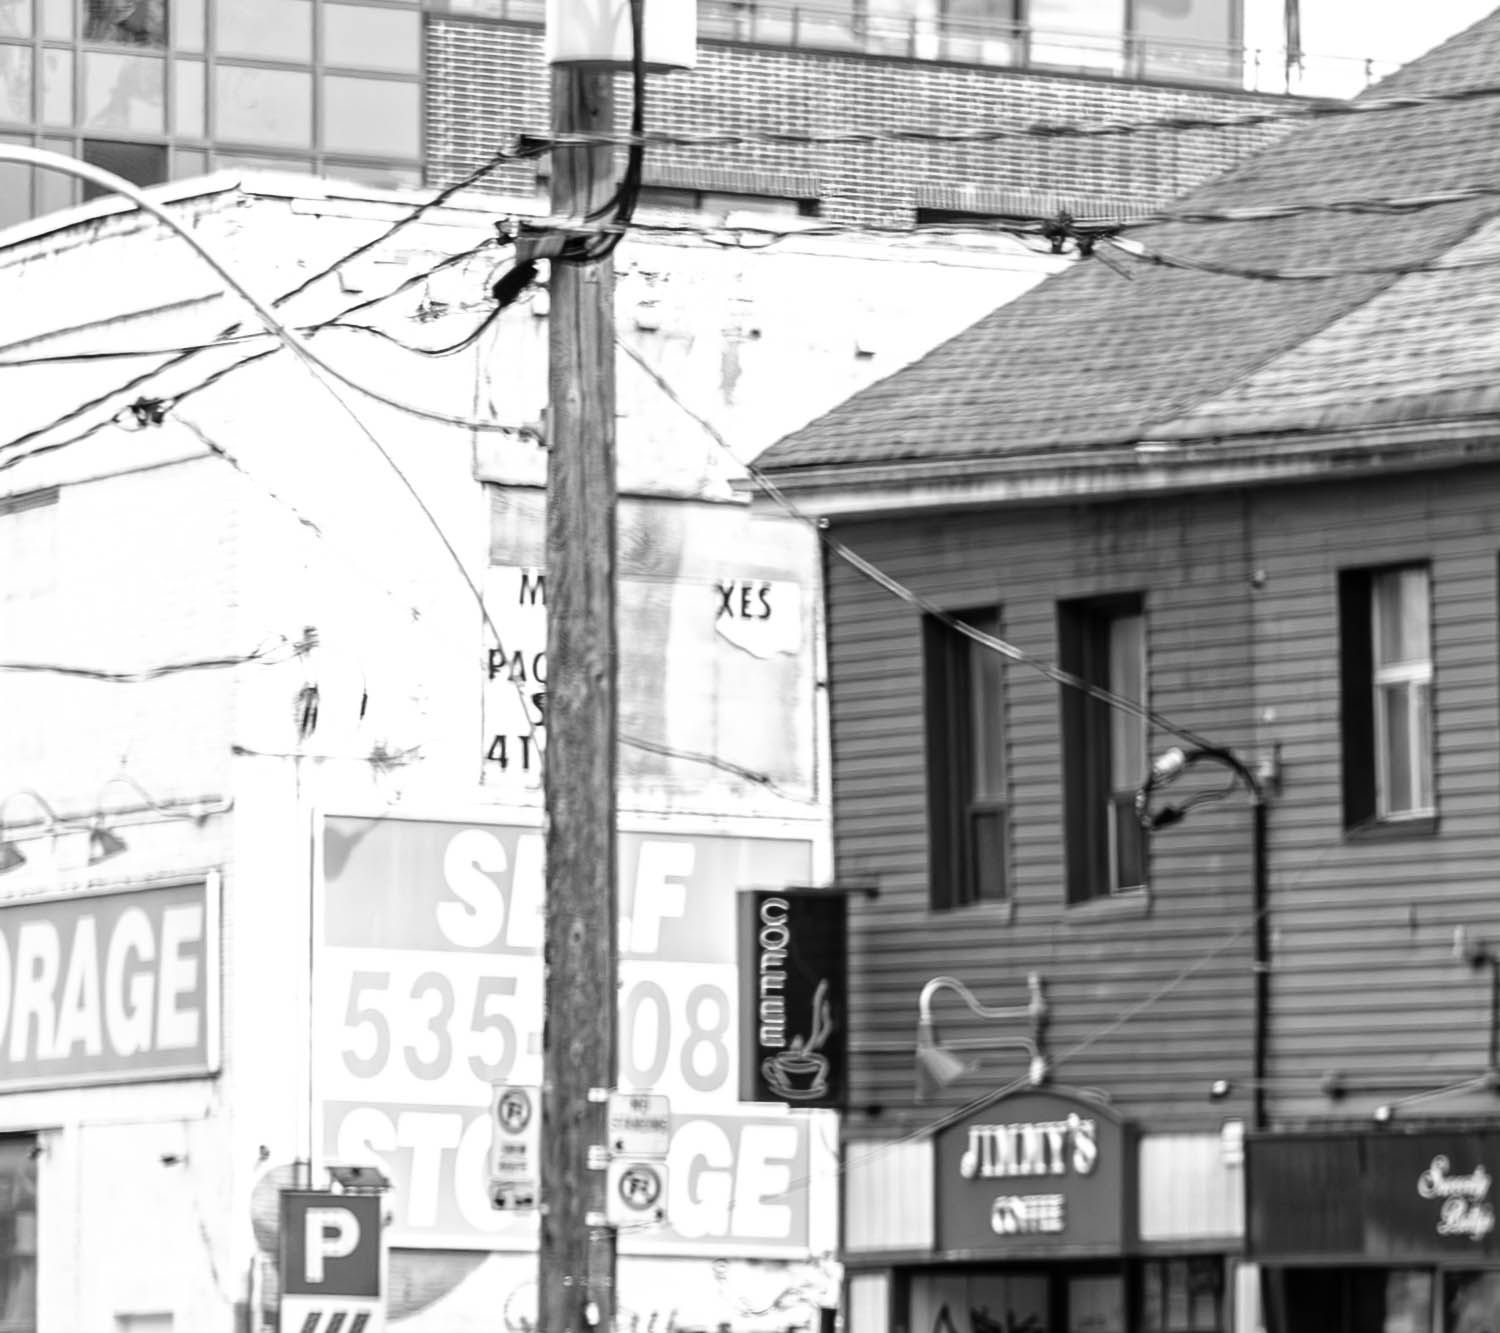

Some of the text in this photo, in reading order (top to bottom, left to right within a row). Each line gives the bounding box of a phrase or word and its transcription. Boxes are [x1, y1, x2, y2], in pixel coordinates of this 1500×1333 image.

[0, 904, 204, 1064] RAGE
[759, 897, 790, 1047] COFFEE
[960, 1112, 1097, 1178] JIMMY'S
[305, 1206, 360, 1284] P
[991, 1194, 1064, 1234] COFFEE
